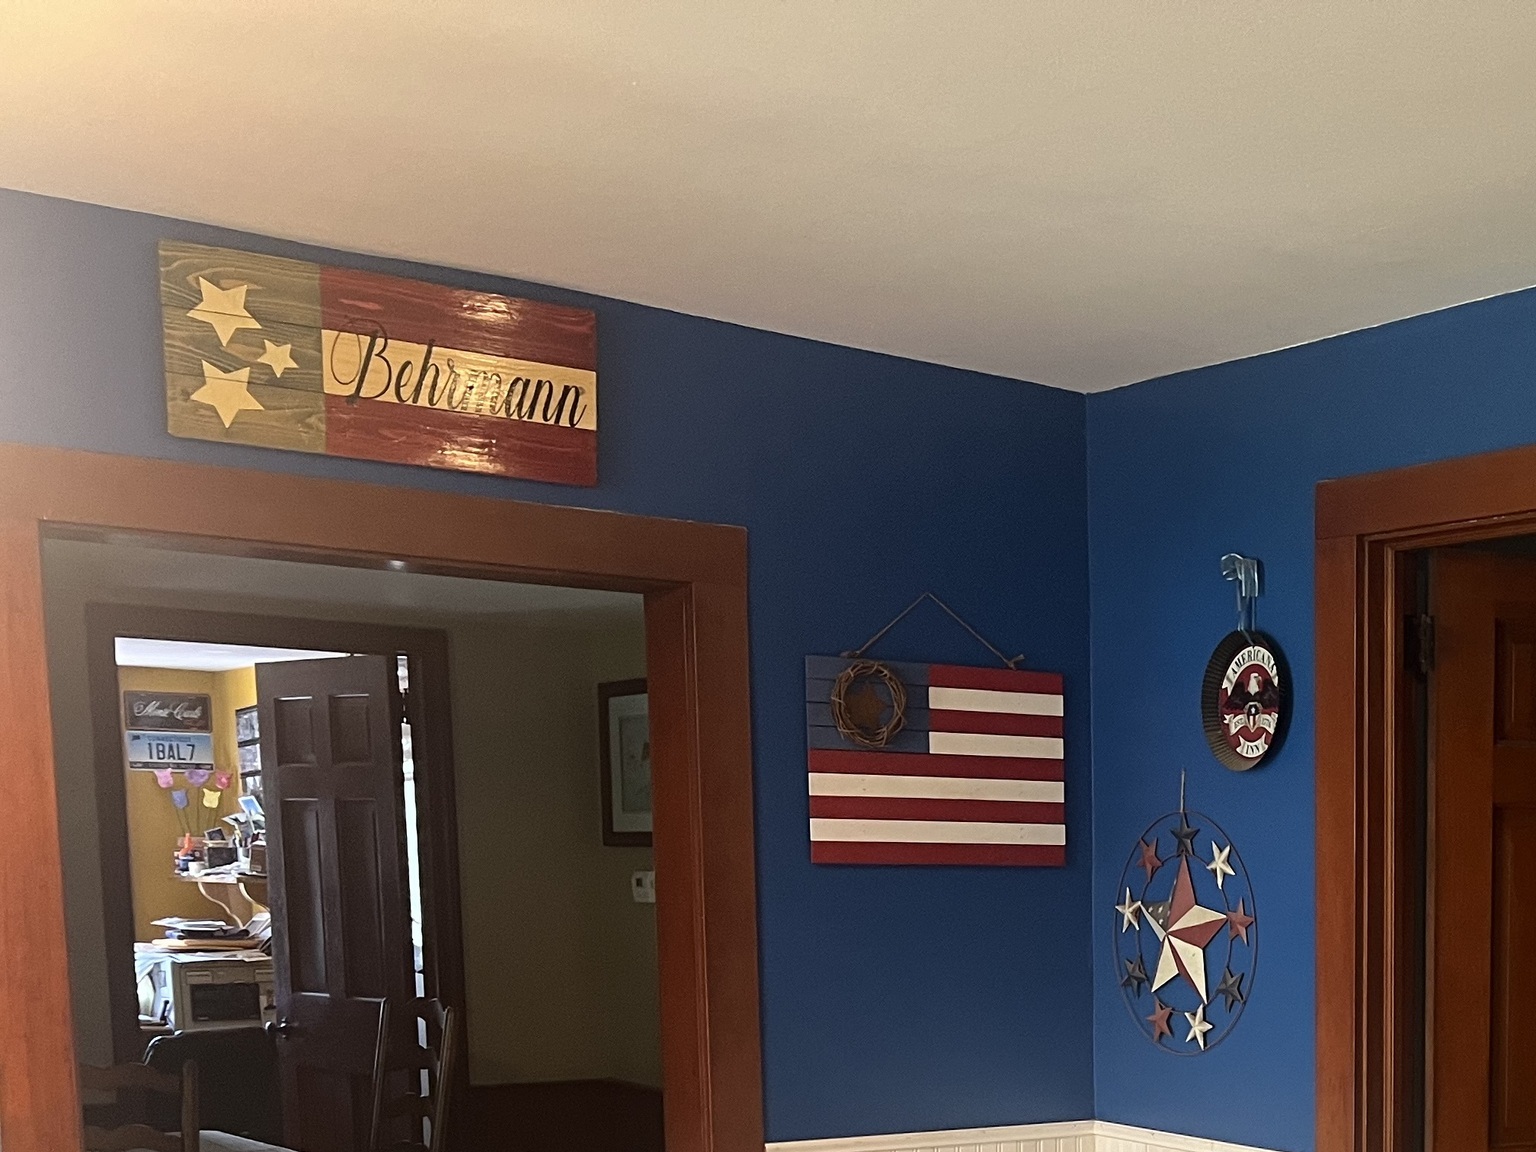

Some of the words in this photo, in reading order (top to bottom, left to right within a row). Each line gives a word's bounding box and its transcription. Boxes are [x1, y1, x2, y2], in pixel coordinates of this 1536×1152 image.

[330, 317, 588, 429] Behrmann
[147, 742, 196, 761] 1BAL7
[1246, 744, 1261, 755] INN
